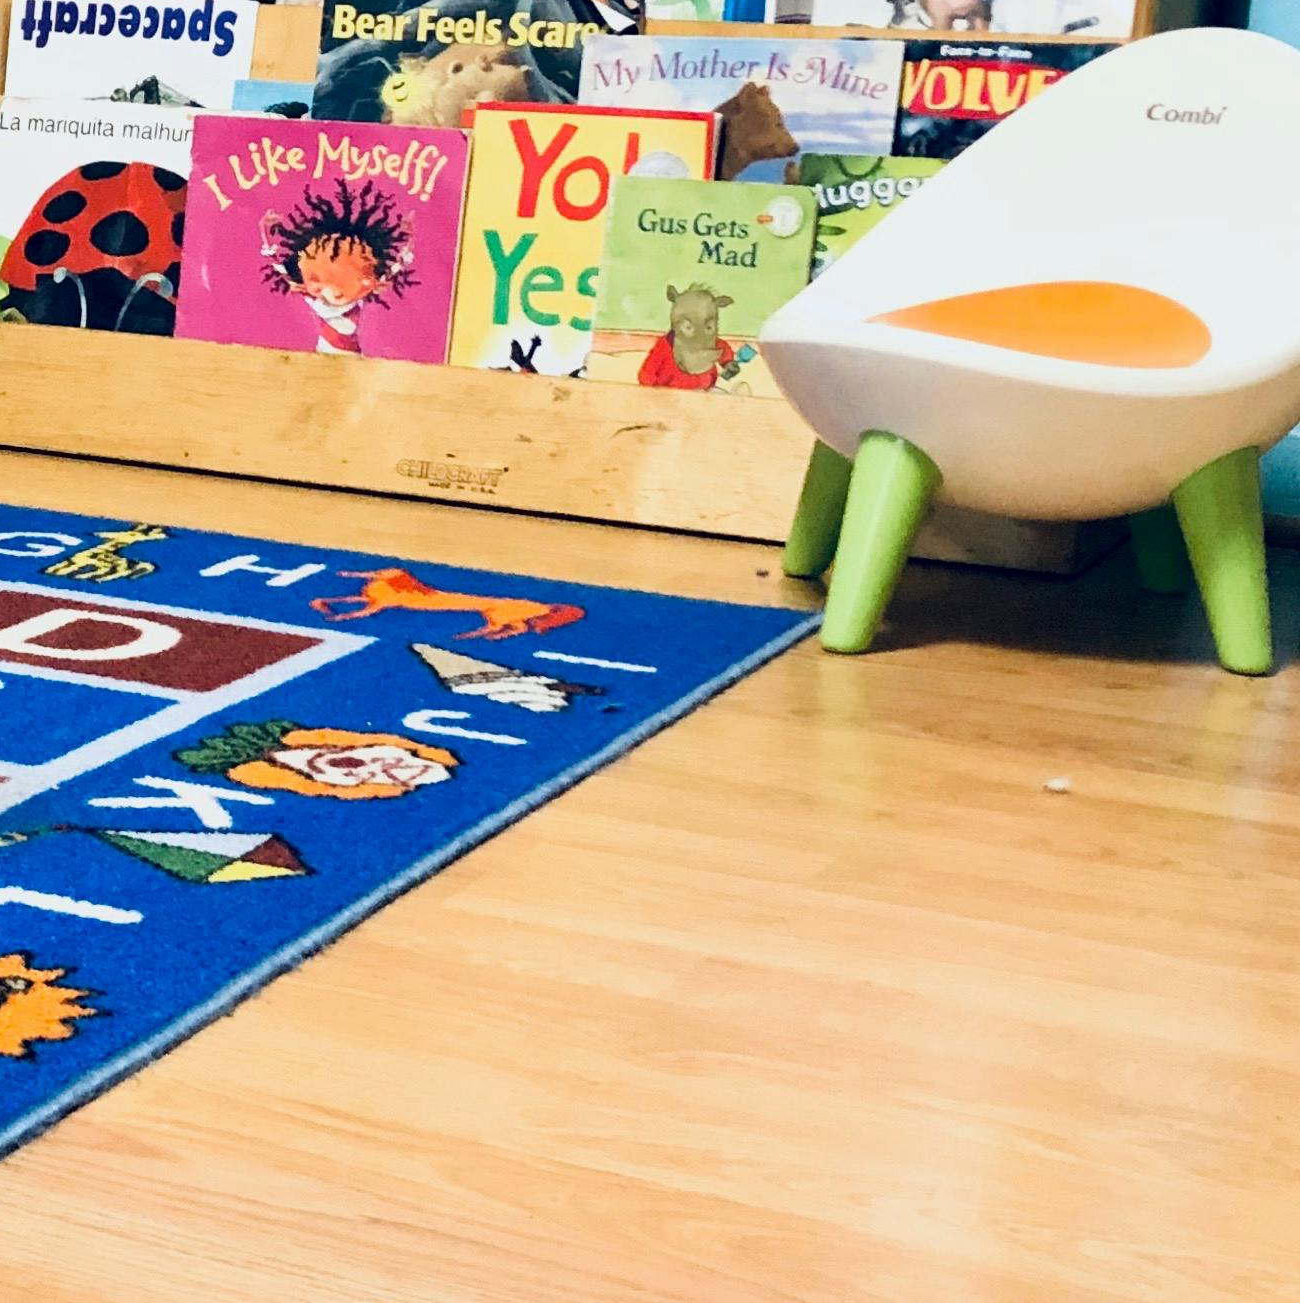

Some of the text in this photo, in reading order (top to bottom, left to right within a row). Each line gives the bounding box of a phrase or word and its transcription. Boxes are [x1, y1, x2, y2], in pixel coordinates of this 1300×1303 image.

[332, 5, 608, 48] Bear Feels Scare
[592, 59, 641, 93] My
[649, 50, 760, 84] Mother
[765, 59, 790, 83] Is
[792, 55, 889, 101] Mine
[0, 112, 20, 131] La
[27, 116, 114, 139] mariquita
[1147, 103, 1228, 125] Combi
[203, 131, 448, 211] I Like Myself!
[637, 208, 749, 239] Gus Gets
[698, 241, 759, 268] Mad
[483, 231, 599, 331] Yes
[200, 555, 326, 587] H
[402, 709, 527, 745] J
[88, 775, 275, 829] K
